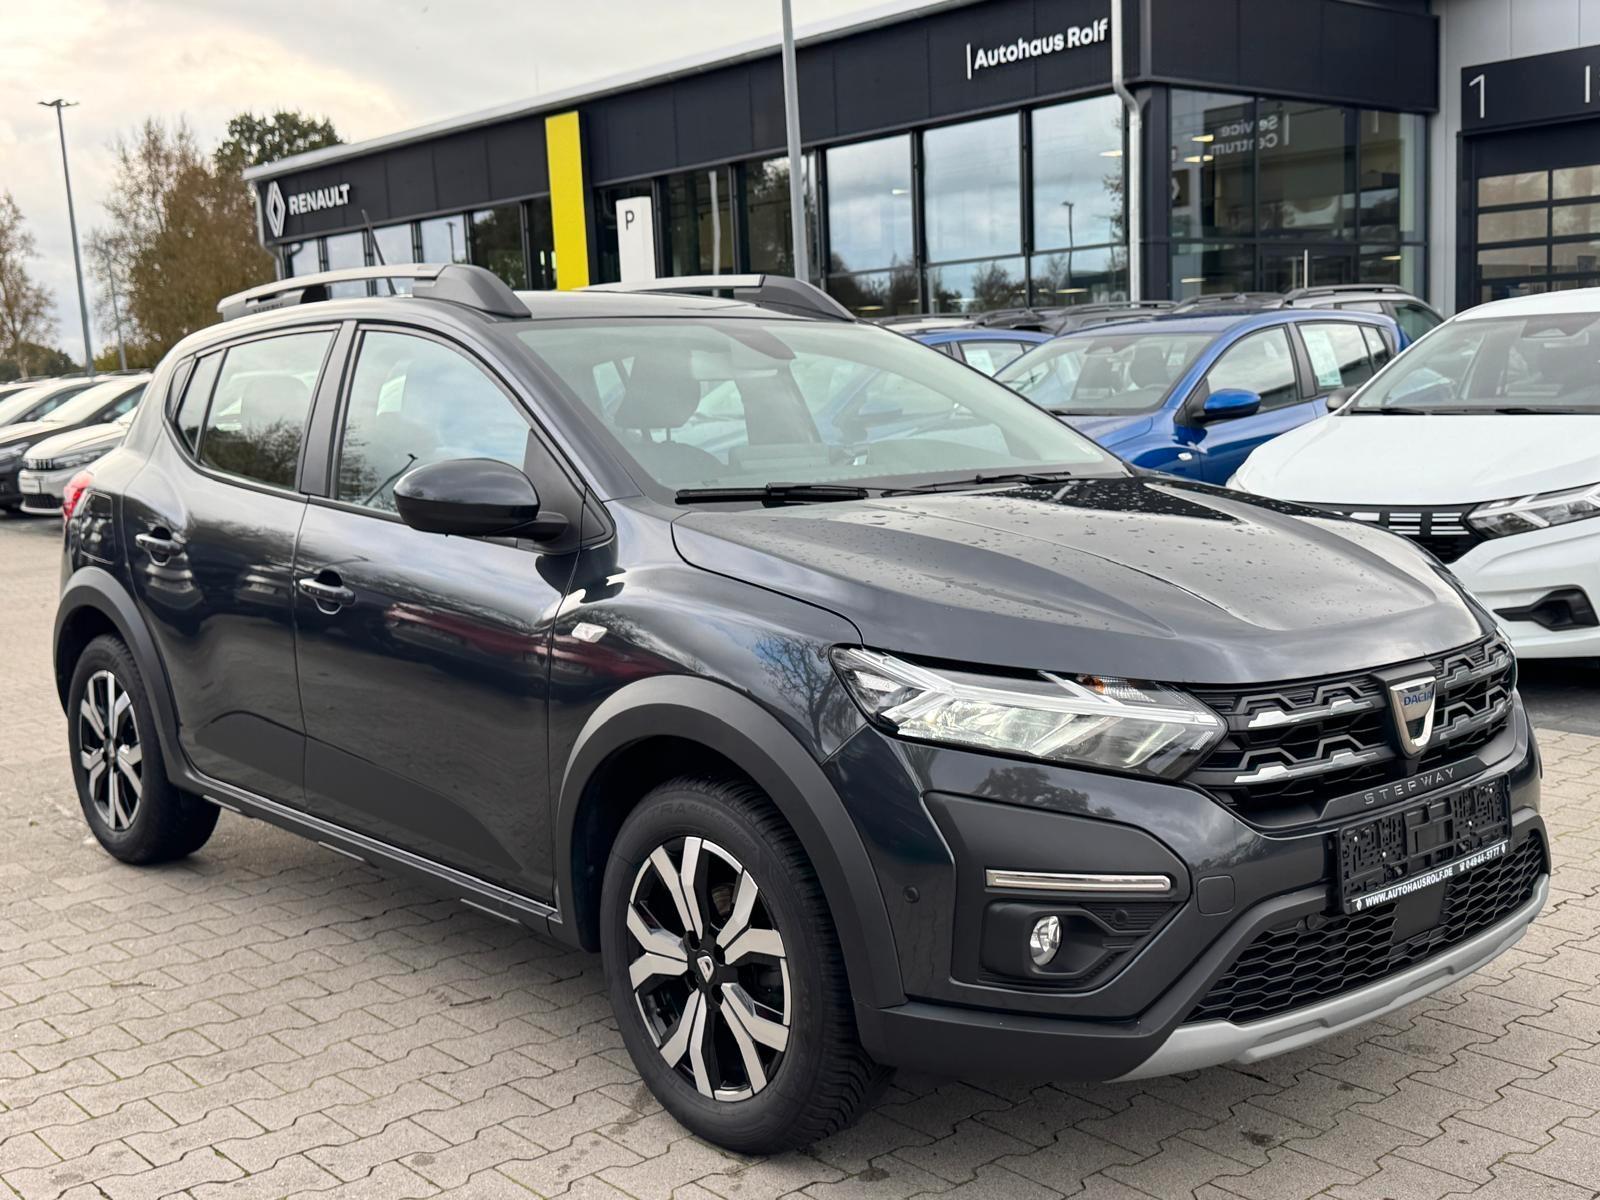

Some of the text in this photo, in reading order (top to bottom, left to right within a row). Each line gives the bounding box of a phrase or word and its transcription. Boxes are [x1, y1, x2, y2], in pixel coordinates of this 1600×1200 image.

[974, 18, 1108, 69] Autohaus Rolf
[1469, 74, 1485, 119] 1
[288, 184, 350, 215] RENAULT
[625, 210, 635, 231] P
[1404, 691, 1432, 705] DACIA
[1364, 768, 1454, 805] STEPWAY
[1365, 867, 1453, 907] WWW.AUTOHAUSROLF.DE
